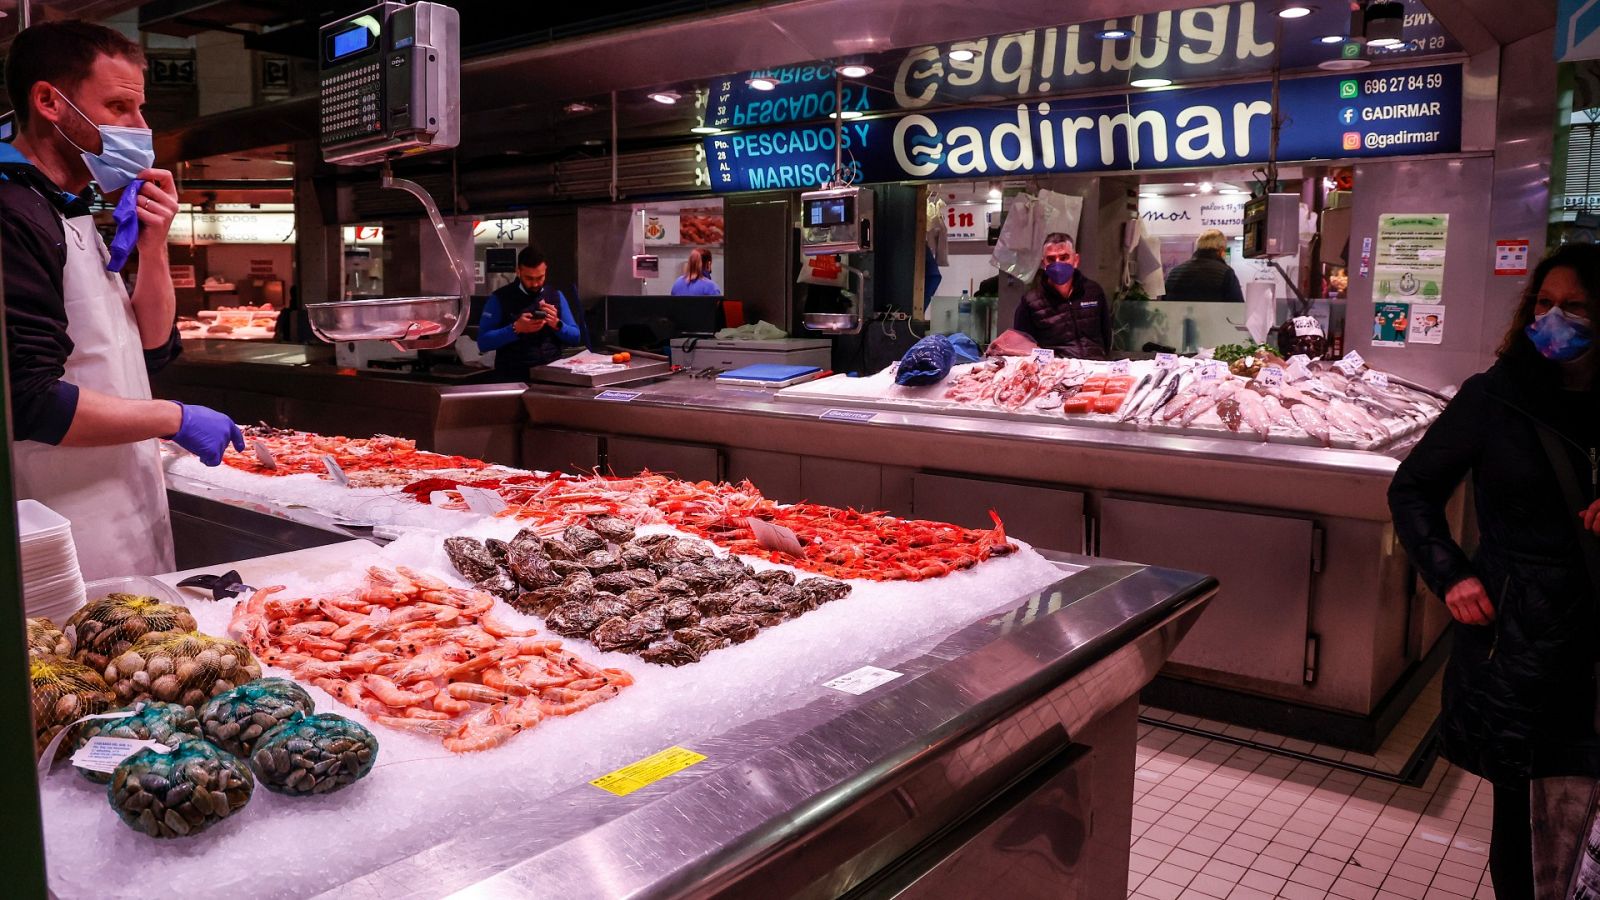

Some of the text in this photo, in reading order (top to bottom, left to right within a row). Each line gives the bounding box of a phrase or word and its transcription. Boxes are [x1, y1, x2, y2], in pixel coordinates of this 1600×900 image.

[1364, 73, 1442, 94] 696 27 84 59
[1362, 102, 1440, 121] GADIRMAR
[714, 140, 729, 150] Pto.
[732, 123, 869, 158] PESCADOS Y
[892, 101, 1273, 177] Gadirmar
[1364, 130, 1440, 149] @gadirmar
[717, 152, 727, 160] 28
[720, 163, 731, 171] AL
[722, 174, 732, 182] 32
